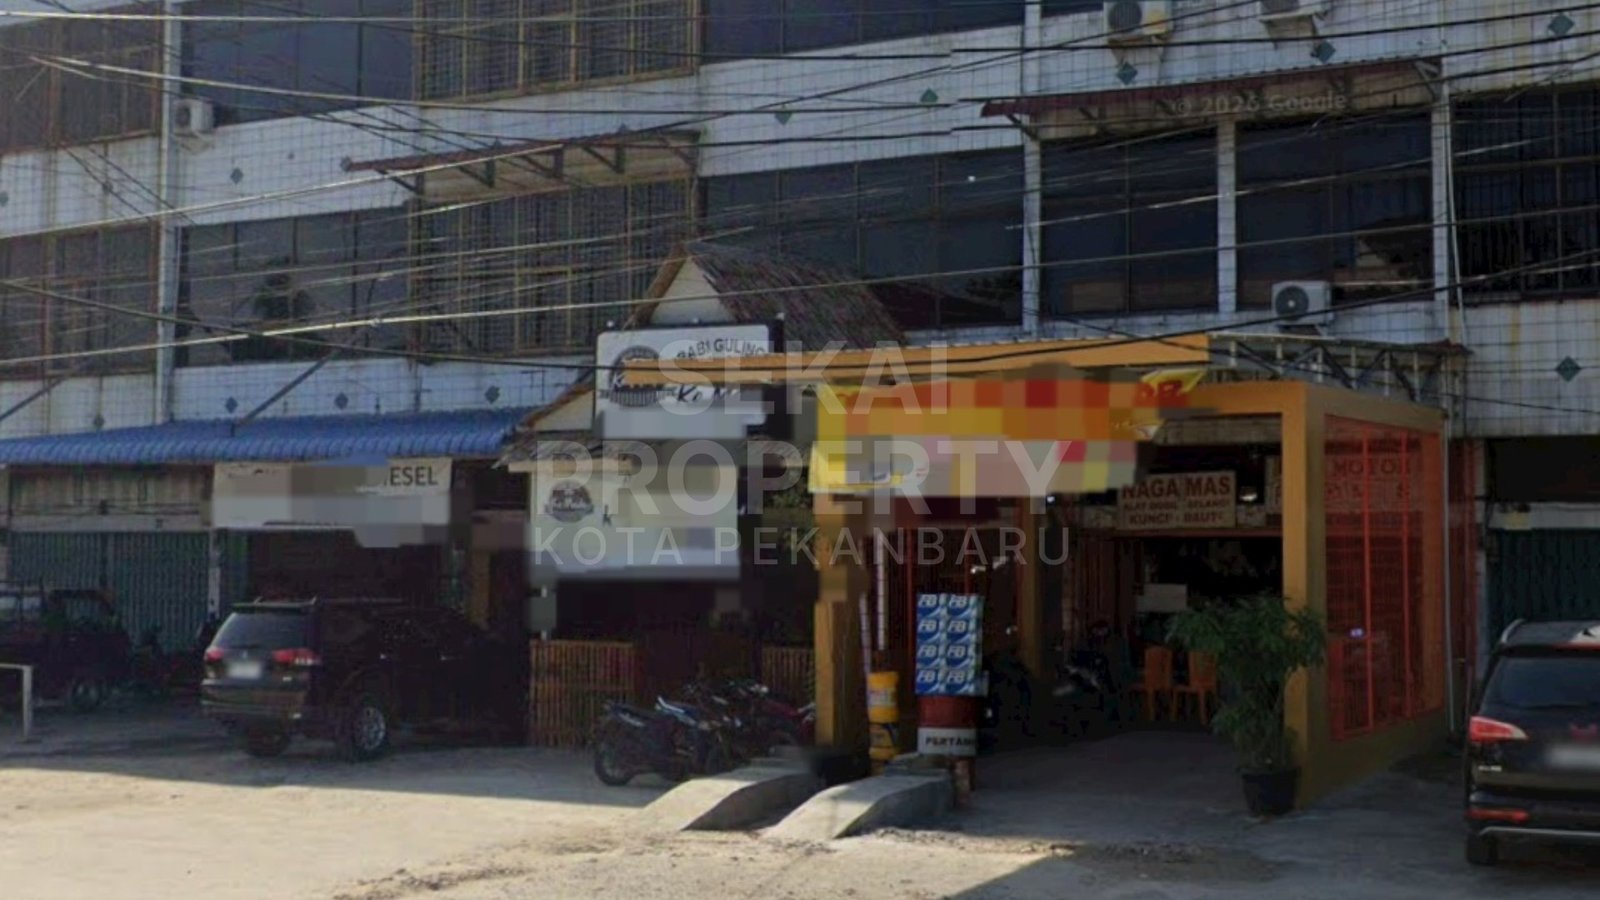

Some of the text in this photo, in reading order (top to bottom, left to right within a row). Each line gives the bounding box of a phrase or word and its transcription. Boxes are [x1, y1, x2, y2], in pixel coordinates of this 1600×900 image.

[384, 466, 438, 487] ESEL
[1122, 475, 1230, 499] NAGA MAS
